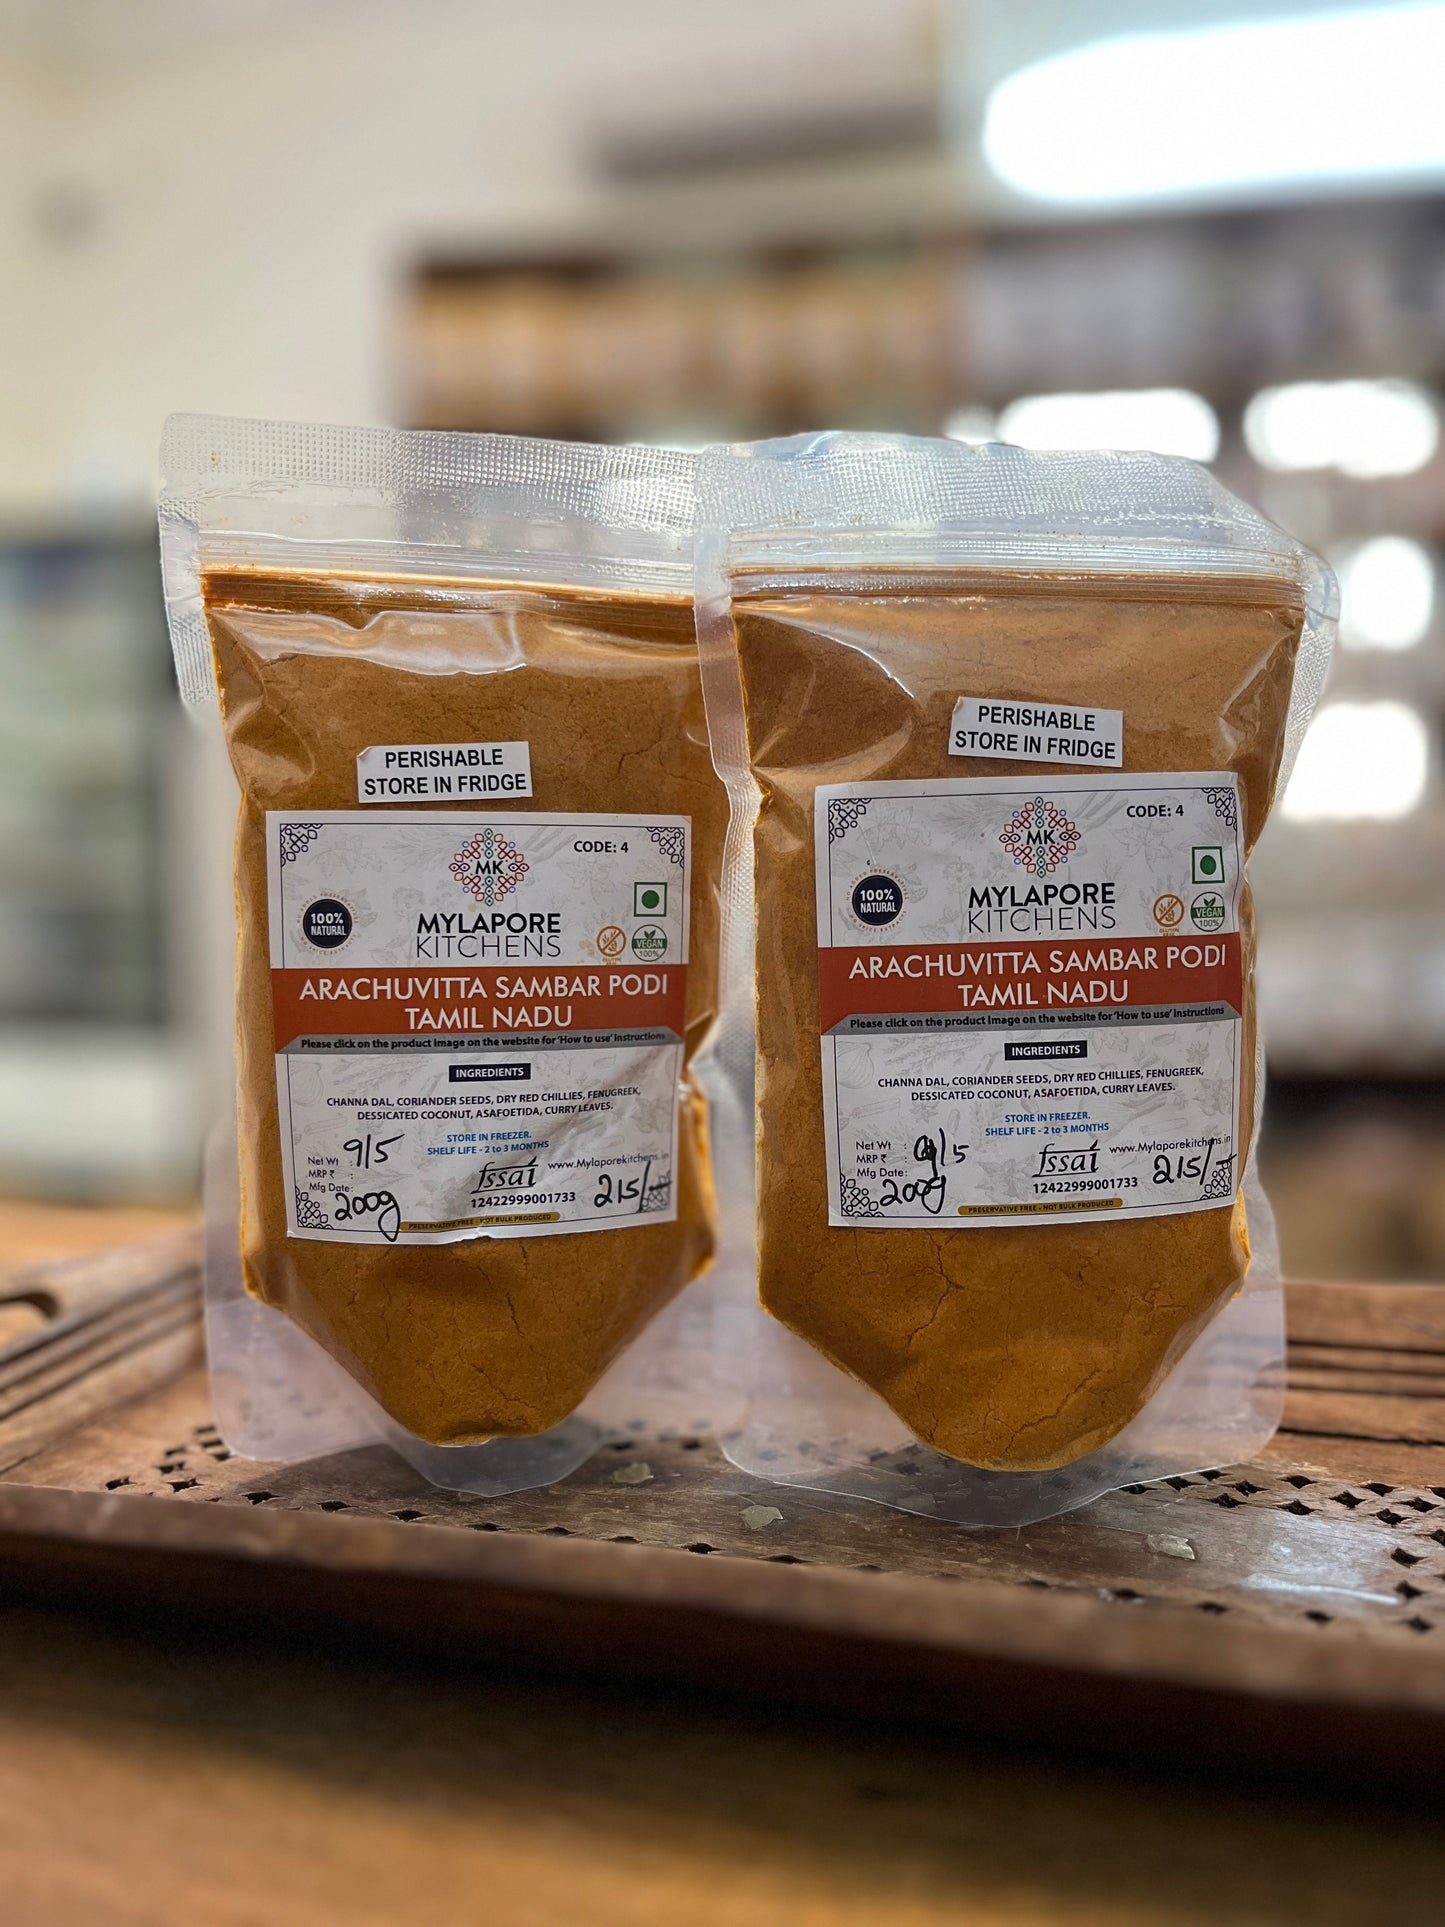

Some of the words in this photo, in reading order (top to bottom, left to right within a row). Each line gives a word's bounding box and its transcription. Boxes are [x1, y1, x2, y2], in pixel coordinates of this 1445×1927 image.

[978, 705, 1096, 731] PERISHABLE
[955, 730, 1018, 751] STORE
[1024, 735, 1041, 754] IN
[1047, 737, 1115, 760] FRIDGE
[385, 749, 503, 768] PERISHABLE
[364, 777, 428, 795] STORE
[434, 776, 451, 793] IN
[458, 773, 527, 793] FRIDGE
[1126, 805, 1171, 818] CODE:
[1175, 805, 1184, 817] 4
[1026, 830, 1055, 845] MK
[574, 841, 617, 853] CODE:
[620, 842, 629, 853] 4
[475, 861, 504, 875] MK
[860, 889, 894, 901] 100%
[969, 882, 1115, 908] MYLAPORE
[860, 902, 897, 913] NATURAL
[1196, 908, 1223, 917] VEGAN
[311, 913, 344, 924] 100%
[417, 913, 561, 934] MYLAPORE
[968, 906, 1116, 934] KITCHENS
[311, 925, 347, 936] NATURAL
[417, 935, 561, 958] KITCHENS
[636, 939, 663, 948] VEGAN
[849, 952, 1041, 979] ARACHUVITTA
[1050, 948, 1160, 973] SAMBAR
[1166, 944, 1226, 969] PODI
[300, 977, 487, 1000] ARACHUVITTA
[496, 975, 601, 998] SAMBAR
[609, 974, 667, 995] PODI
[958, 982, 1039, 1007] TAMIL
[1048, 979, 1128, 1005] NADU
[405, 1007, 484, 1030] TAMIL
[493, 1005, 572, 1028] NADU
[850, 1019, 883, 1029] Please
[885, 1018, 908, 1028] click
[910, 1019, 923, 1027] on
[925, 1017, 943, 1027] the
[944, 1016, 986, 1028] product
[1038, 1013, 1055, 1023] the
[1057, 1012, 1096, 1022] website
[1098, 1011, 1112, 1021] for
[1141, 1011, 1151, 1019] to
[301, 1039, 332, 1049] Please
[334, 1039, 356, 1048] click
[372, 1039, 390, 1048] the
[391, 1038, 432, 1050] product
[467, 1039, 480, 1047] on
[482, 1037, 500, 1047] the
[501, 1036, 540, 1046] website
[541, 1035, 556, 1045] for
[583, 1035, 593, 1043] to
[1012, 1045, 1081, 1056] INGREDIENTS
[456, 1067, 524, 1079] INGREDIENTS
[878, 1078, 923, 1088] CHANNA
[925, 1077, 950, 1087] DAL,
[952, 1076, 1014, 1086] CORIANDER
[1016, 1074, 1051, 1085] SEEDS,
[1053, 1073, 1075, 1083] DRY
[1077, 1072, 1096, 1081] RED
[1098, 1070, 1144, 1080] CHILLIES,
[1146, 1066, 1204, 1078] FENUGREEK,
[327, 1097, 369, 1107] CHANNA
[371, 1097, 394, 1107] DAL,
[397, 1096, 457, 1106] CORIANDER
[459, 1095, 494, 1106] SEEDS,
[496, 1095, 518, 1104] DRY
[519, 1094, 539, 1103] RED
[541, 1091, 585, 1102] CHILLIES,
[588, 1087, 641, 1099] FENUGREEK,
[911, 1091, 975, 1101] DESSICATED
[977, 1089, 1031, 1099] COCONUT,
[1033, 1086, 1100, 1098] ASAFOETIDA,
[1102, 1084, 1134, 1094] CURRY
[1136, 1082, 1176, 1093] LEAVES.
[357, 1111, 419, 1120] DESSICATED
[421, 1110, 473, 1120] COCONUT,
[476, 1107, 542, 1118] ASAFOETIDA,
[545, 1105, 577, 1115] CURRY
[578, 1102, 613, 1112] LEAVES.
[1005, 1114, 1035, 1123] STORE
[1037, 1114, 1047, 1122] IN
[1049, 1112, 1091, 1121] FREEZER.
[447, 1134, 476, 1142] STORE
[478, 1133, 488, 1141] IN
[490, 1131, 532, 1140] FREEZER.
[985, 1127, 1014, 1136] SHELF
[1016, 1126, 1036, 1135] LIFE
[1043, 1126, 1049, 1134] 2
[1051, 1126, 1061, 1134] to
[1063, 1125, 1068, 1133] 3
[1070, 1122, 1109, 1133] MONTHS
[427, 1147, 456, 1155] SHELF
[457, 1146, 477, 1155] LIFE
[491, 1145, 501, 1153] to
[503, 1144, 509, 1152] 3
[511, 1141, 549, 1151] MONTHS
[856, 1141, 874, 1150] Net
[876, 1141, 892, 1150] Wt
[1109, 1134, 1231, 1154] www.Mylaporekitchens.in
[308, 1157, 324, 1166] Net
[326, 1157, 339, 1166] Wt
[548, 1152, 670, 1169] www.Mylaporekitchens.in
[856, 1154, 878, 1163] MRP
[1032, 1139, 1101, 1178] fssai
[308, 1169, 327, 1178] MRP
[470, 1156, 539, 1194] fssai
[857, 1168, 876, 1179] Mfg
[879, 1168, 908, 1177] Date:
[309, 1183, 326, 1193] Mfg
[328, 1183, 354, 1192] Date:
[1033, 1177, 1138, 1194] 12422999001733
[471, 1192, 576, 1208] 12422999001733
[968, 1205, 1018, 1213] PRESERVATIVE
[1059, 1202, 1076, 1210] BULK
[1077, 1200, 1114, 1208] PRODUCED
[409, 1220, 456, 1229] PRESERVATIVE
[514, 1214, 552, 1222] PRODUCED
